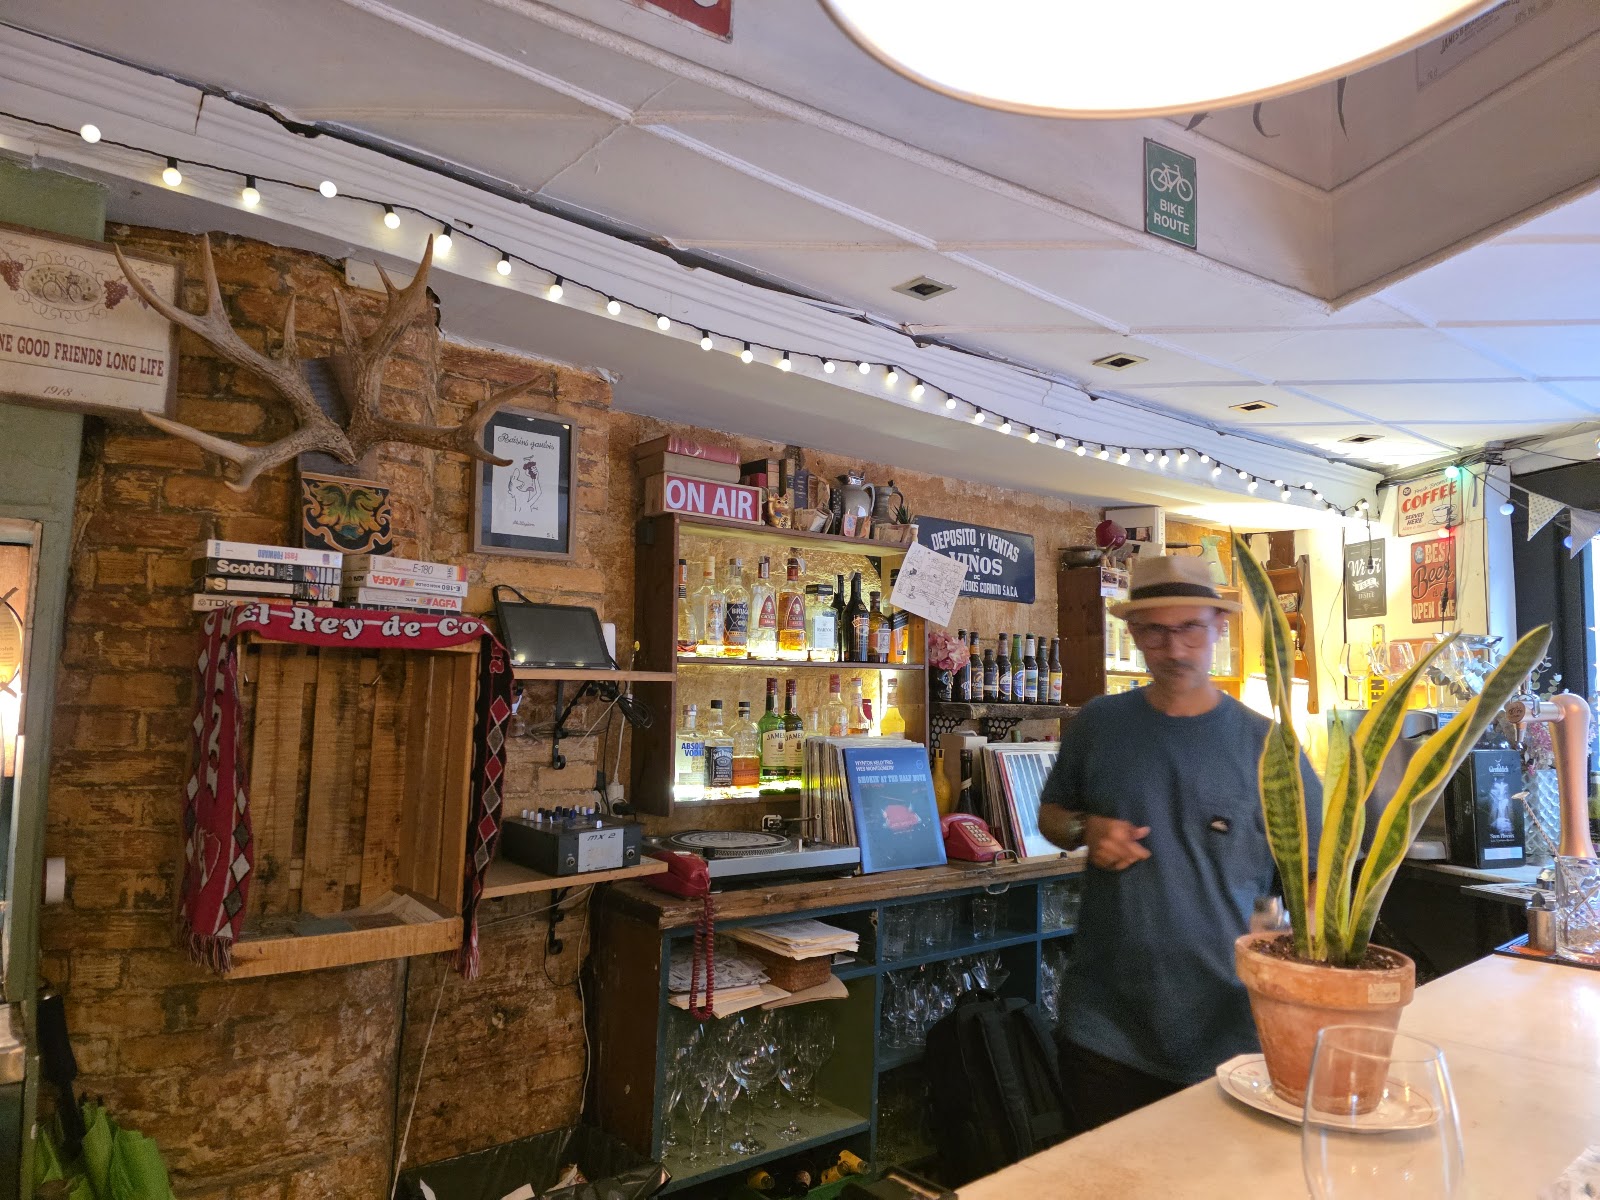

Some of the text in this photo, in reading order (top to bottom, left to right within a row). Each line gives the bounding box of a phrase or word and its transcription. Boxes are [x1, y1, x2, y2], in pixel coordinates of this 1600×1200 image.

[1160, 199, 1184, 218] BIKE
[1153, 212, 1190, 235] ROUTE
[17, 336, 50, 358] GOOD
[54, 342, 103, 367] FRIENDS
[106, 350, 136, 373] LONG
[140, 356, 164, 377] LIFE
[43, 385, 73, 397] 1918
[666, 479, 753, 520] ON AIR
[1401, 479, 1458, 513] COFFEE
[931, 528, 1020, 562] DEPOSITO Y VENTAS
[1424, 540, 1453, 565] BEST
[216, 560, 275, 577] Scotch
[412, 563, 434, 575] E-180
[372, 574, 400, 587] AGFA
[441, 584, 461, 592] E-180
[206, 599, 233, 608] TDK
[432, 597, 457, 609] AGFA
[1412, 601, 1435, 620] OPEN
[289, 606, 364, 640] Rey
[381, 614, 422, 638] de
